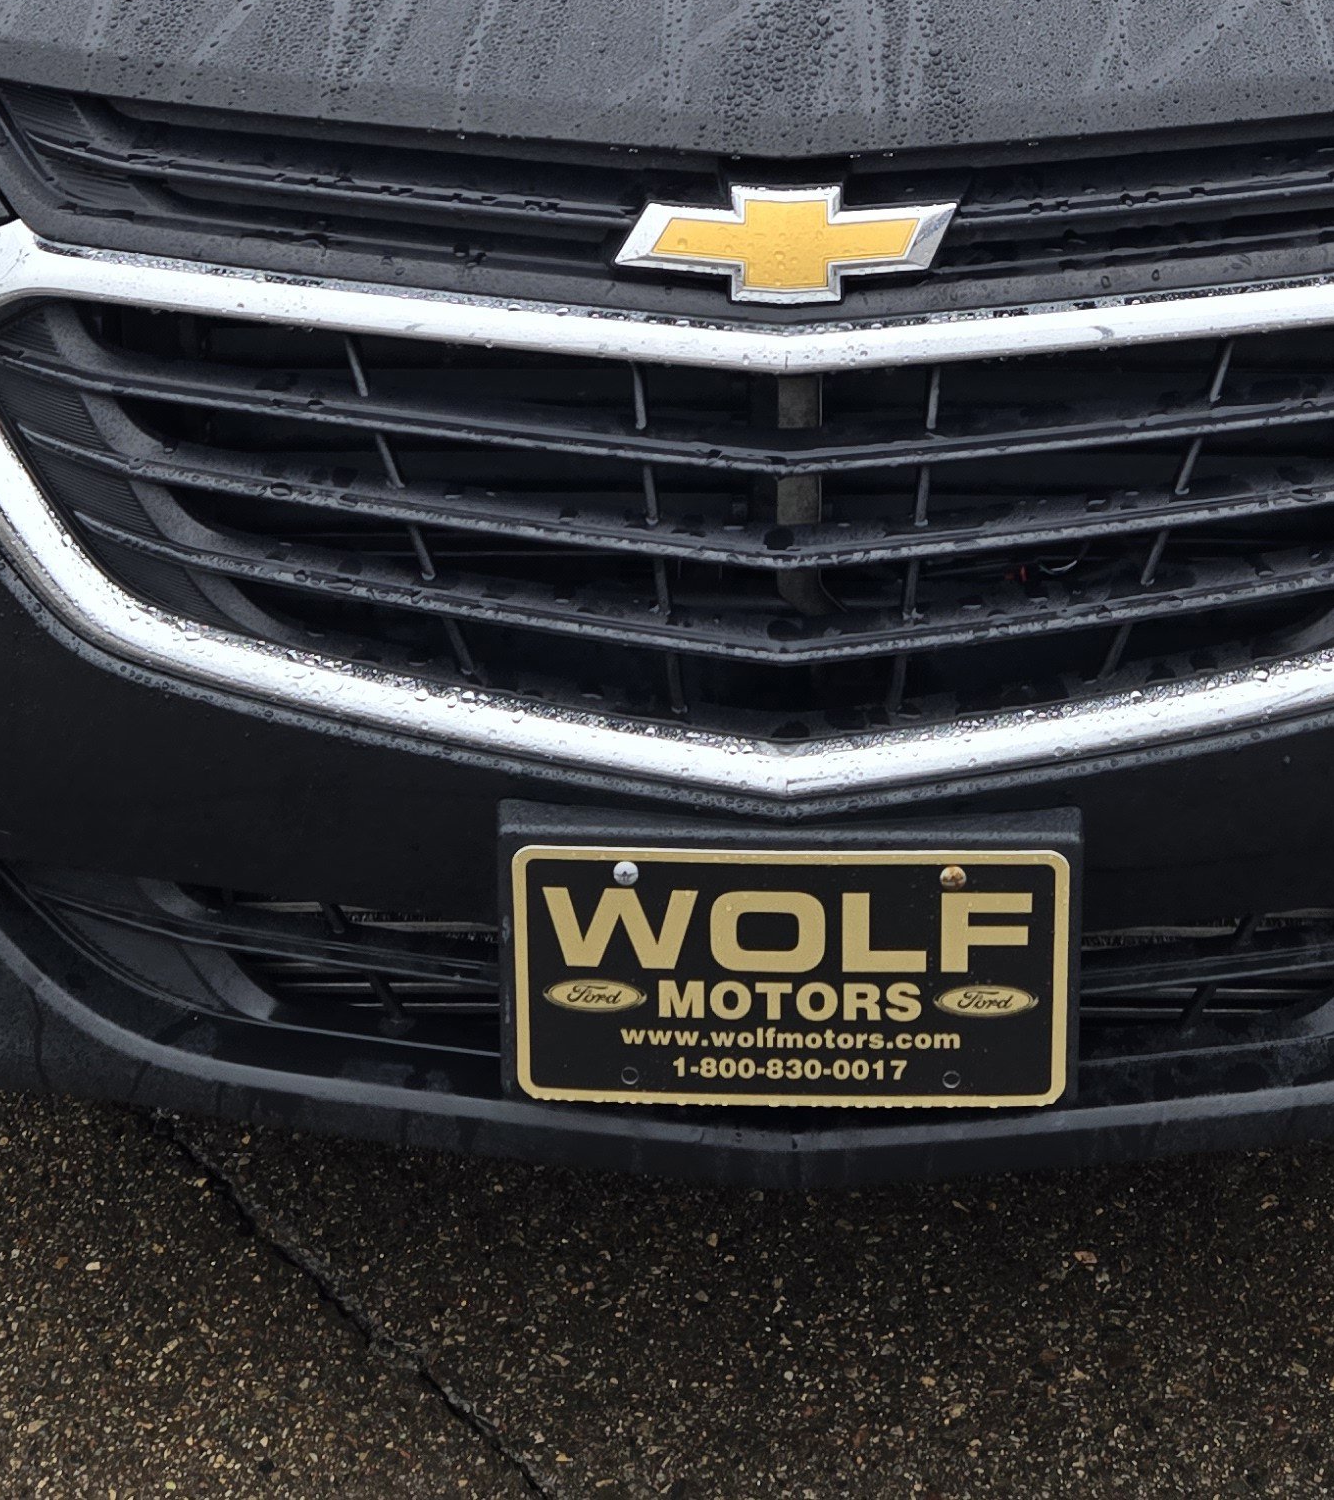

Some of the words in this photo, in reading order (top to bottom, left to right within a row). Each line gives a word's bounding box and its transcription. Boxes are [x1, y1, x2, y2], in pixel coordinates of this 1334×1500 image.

[541, 885, 1034, 974] WOLF
[657, 980, 924, 1022] MOTORS
[620, 1027, 962, 1051] www.wolfmotors.com
[672, 1059, 908, 1081] 1-800-830-0017
